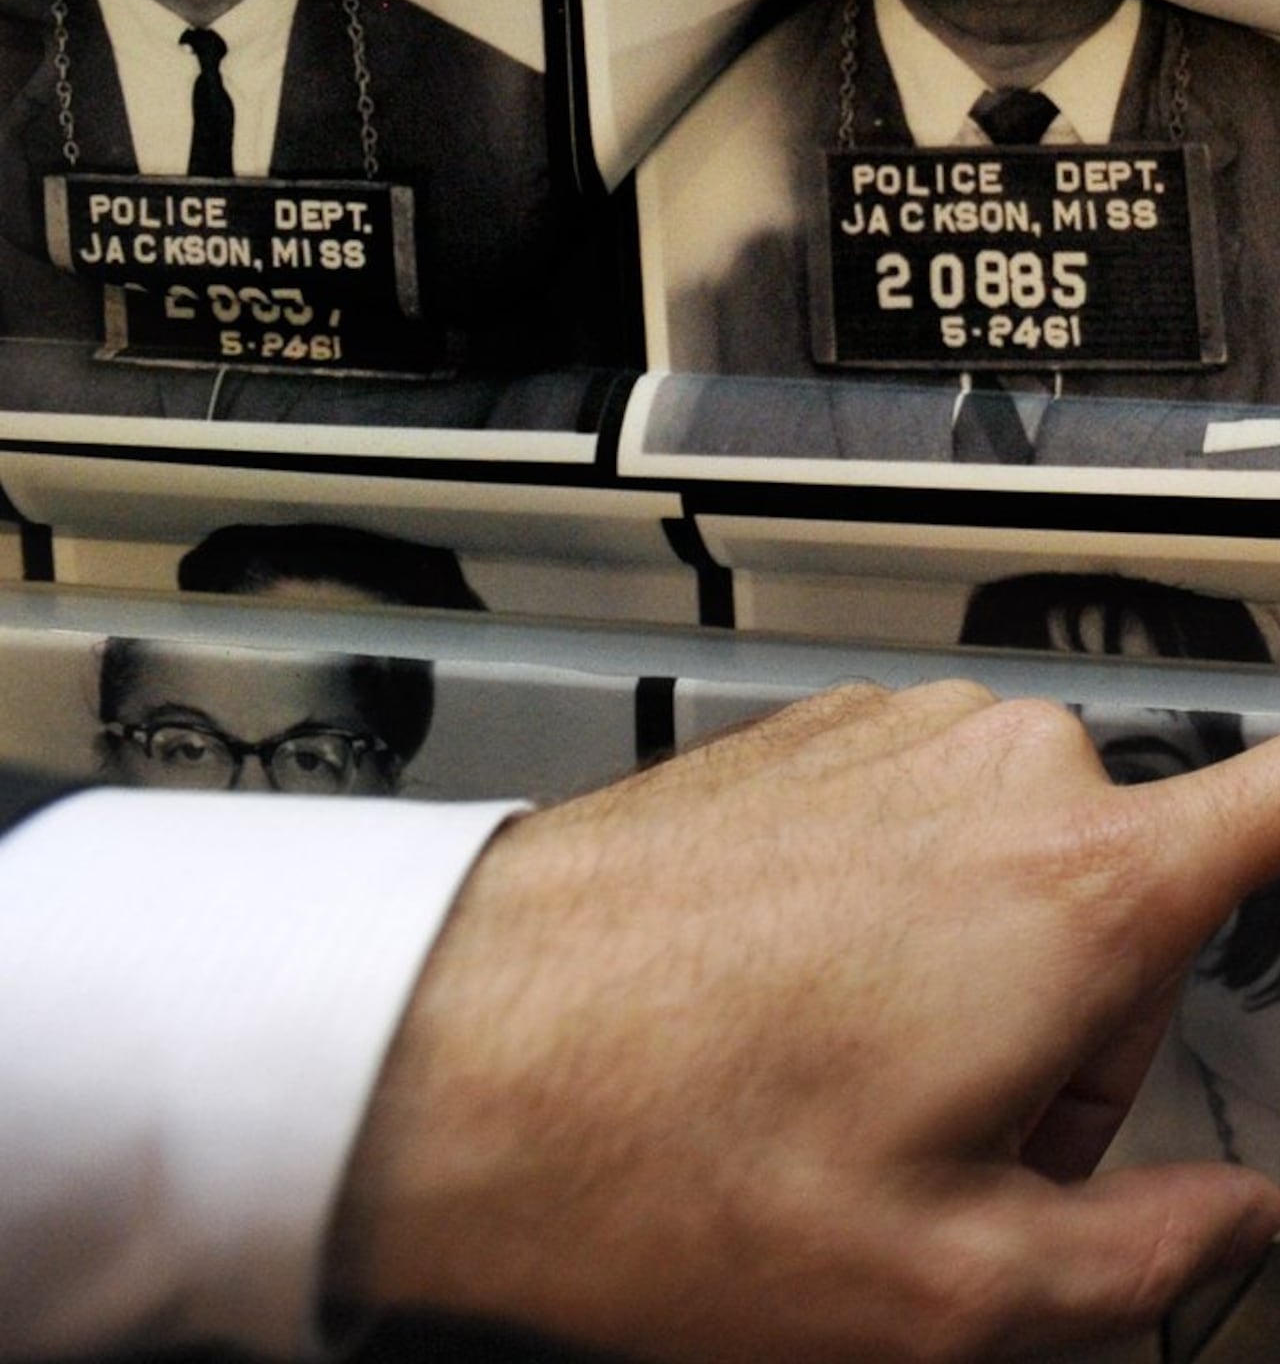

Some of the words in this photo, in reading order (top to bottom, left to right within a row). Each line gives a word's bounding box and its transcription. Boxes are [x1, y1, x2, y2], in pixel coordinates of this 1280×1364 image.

[852, 163, 1004, 195] POLICE
[1056, 160, 1165, 194] DEPT.
[89, 194, 228, 229] POLICE
[275, 199, 373, 234] DEPT.
[840, 199, 1041, 237] JACKSON,
[1053, 199, 1158, 232] MISS
[80, 232, 264, 271] JACKSON,
[272, 238, 367, 270] MISS
[876, 249, 1089, 310] 20885
